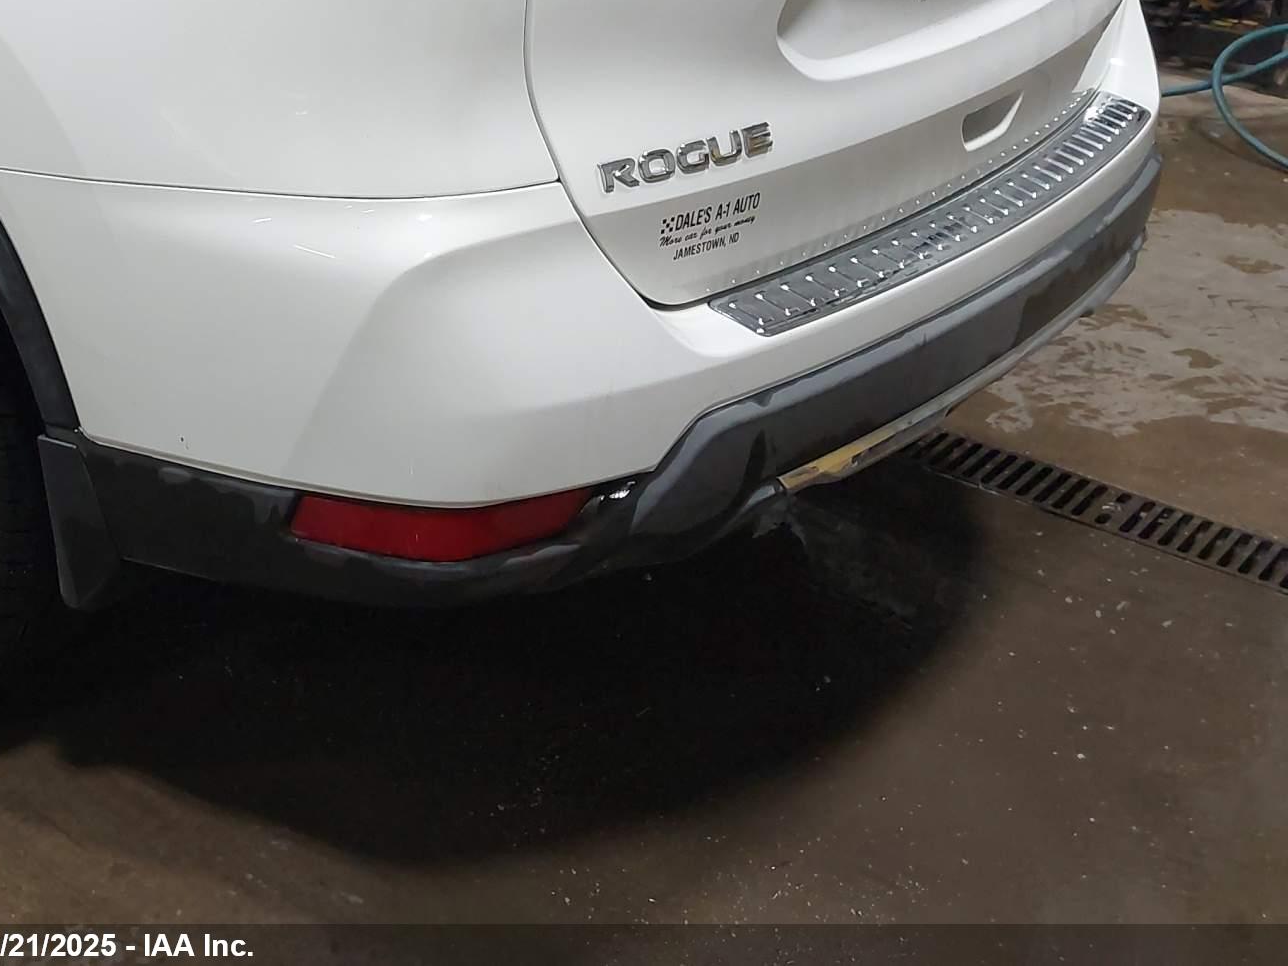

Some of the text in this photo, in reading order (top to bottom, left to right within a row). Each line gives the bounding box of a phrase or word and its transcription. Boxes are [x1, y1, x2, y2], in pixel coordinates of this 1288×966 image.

[597, 122, 773, 194] ROGUE
[675, 192, 760, 232] DALE'S A-1 AUTO
[659, 235, 682, 247] More
[699, 226, 712, 240] for
[673, 232, 740, 260] JAMESTOWN, ND
